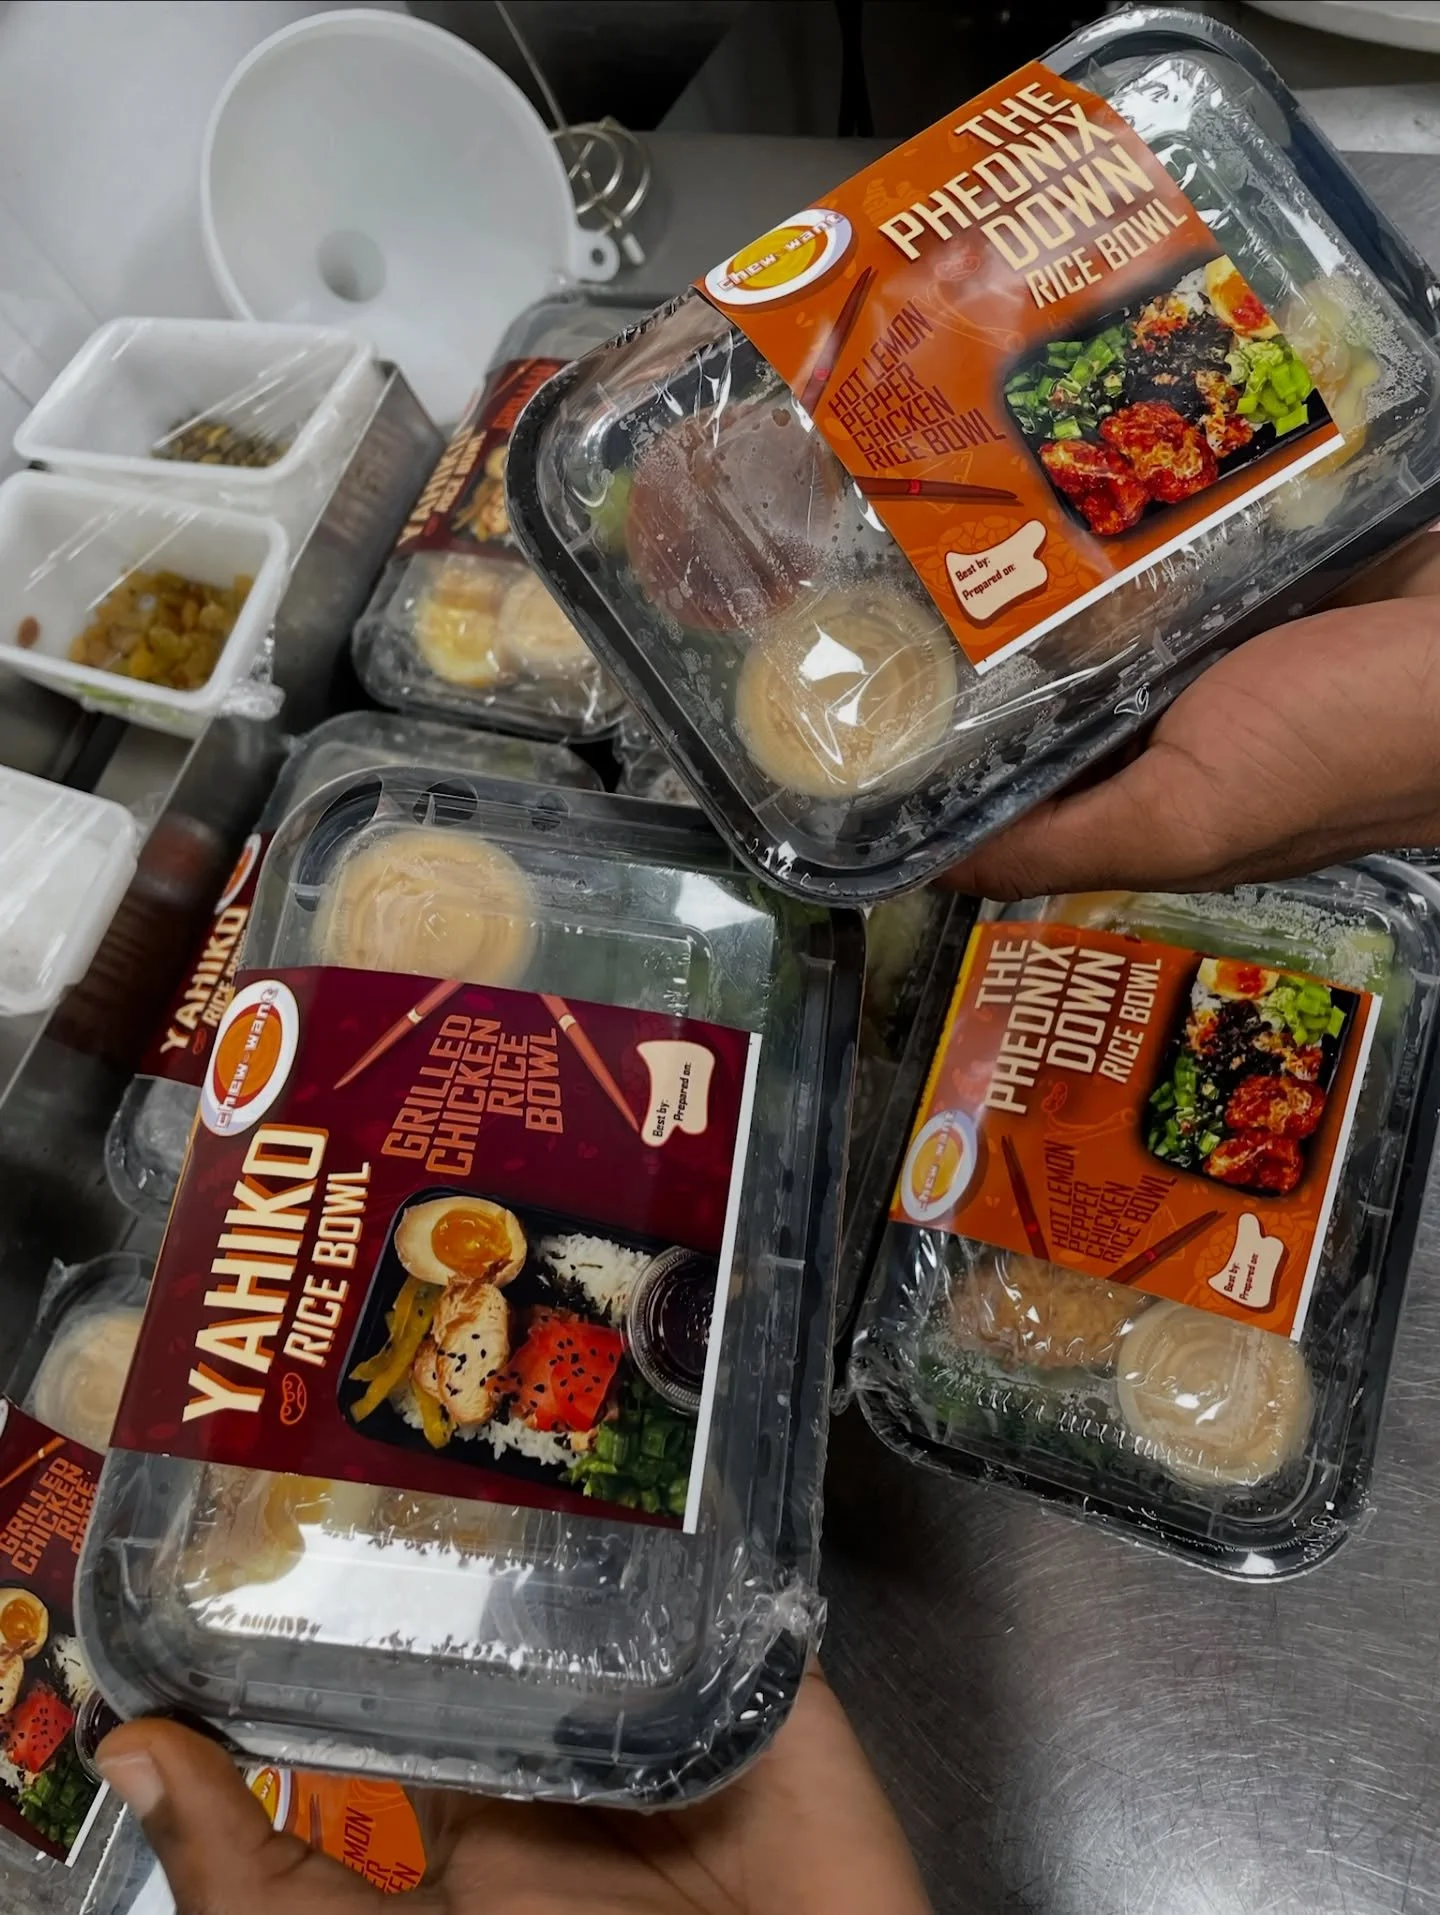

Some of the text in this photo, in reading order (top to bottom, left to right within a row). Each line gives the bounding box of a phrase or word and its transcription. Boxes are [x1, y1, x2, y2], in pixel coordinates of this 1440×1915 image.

[954, 82, 1072, 147] THE
[878, 104, 1114, 261] PHEONIX
[979, 143, 1154, 271] DOWN
[1025, 198, 1188, 310] RICE BOWL
[828, 300, 934, 417] HOT LEMON
[840, 361, 925, 436] PEPPER
[852, 385, 956, 453] CHICKEN
[864, 408, 1007, 471] RICE BOWL
[955, 556, 991, 581] Best by:
[962, 563, 1016, 600] Prepared on:
[160, 904, 248, 1054] YAHIKO
[974, 939, 1028, 1009] THE
[1046, 948, 1126, 1074] DOWN
[984, 940, 1076, 1115] PHEONIX
[1098, 959, 1162, 1084] RICE BOWL
[216, 1062, 249, 1129] chew
[381, 1015, 472, 1160] GRILLED
[425, 1018, 501, 1176] CHICKEN
[486, 1032, 528, 1117] RICE
[525, 1028, 564, 1134] BOWL
[674, 1061, 692, 1122] Prepared on:
[652, 1115, 666, 1137] Best
[1043, 1140, 1075, 1248] HOT LEMON
[1069, 1181, 1102, 1253] PEPPER
[1085, 1180, 1135, 1259] CHICKEN
[1102, 1174, 1178, 1263] RICE BOWL
[182, 1123, 330, 1422] YAHIKO
[282, 1161, 371, 1367] RICE BOWL
[1224, 1274, 1236, 1292] Best
[0, 1457, 68, 1556] GRILLED
[11, 1462, 84, 1575] CHICKEN
[55, 1477, 95, 1542] RICE
[342, 1806, 374, 1876] EMON
